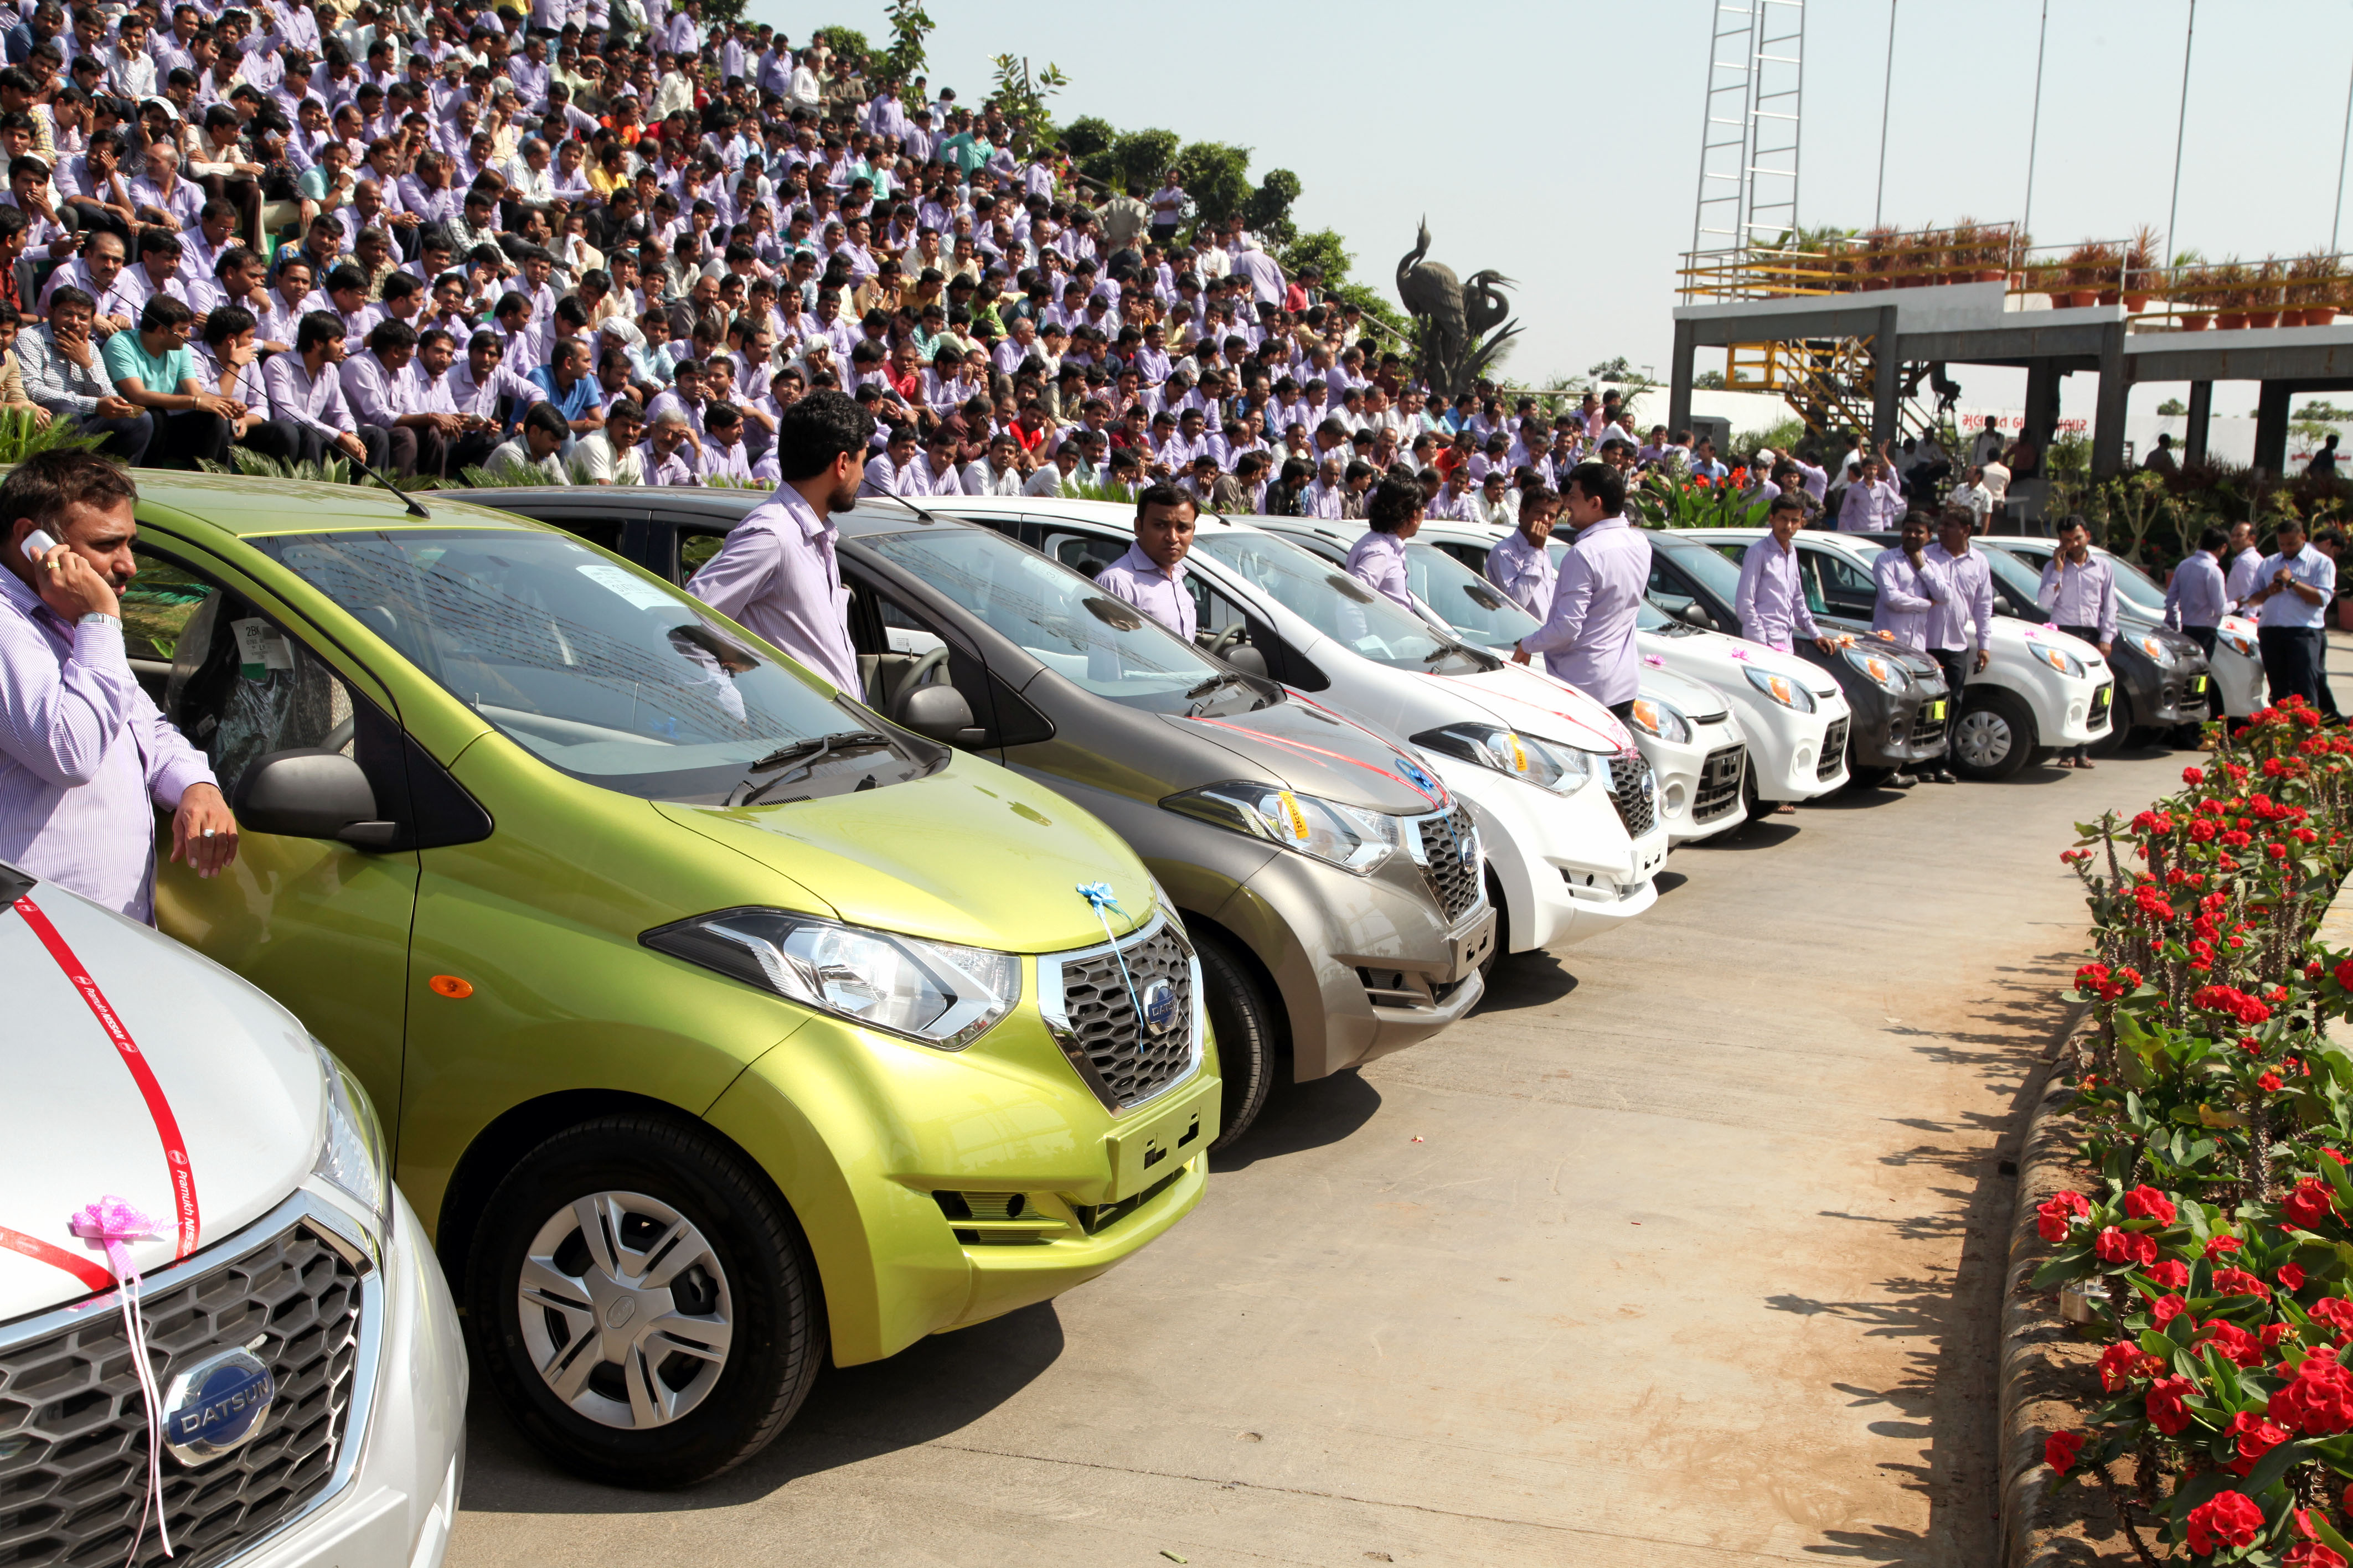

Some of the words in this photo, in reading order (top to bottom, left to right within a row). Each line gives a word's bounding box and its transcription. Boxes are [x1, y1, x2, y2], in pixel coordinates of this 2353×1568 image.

[1288, 801, 1302, 829] PRAMUKH
[84, 987, 108, 1013] Pramukh
[101, 1013, 126, 1040] NISSAN
[1152, 1000, 1176, 1017] DATSU
[177, 1169, 194, 1216] Pramukh
[180, 1377, 269, 1434] DATSUN
